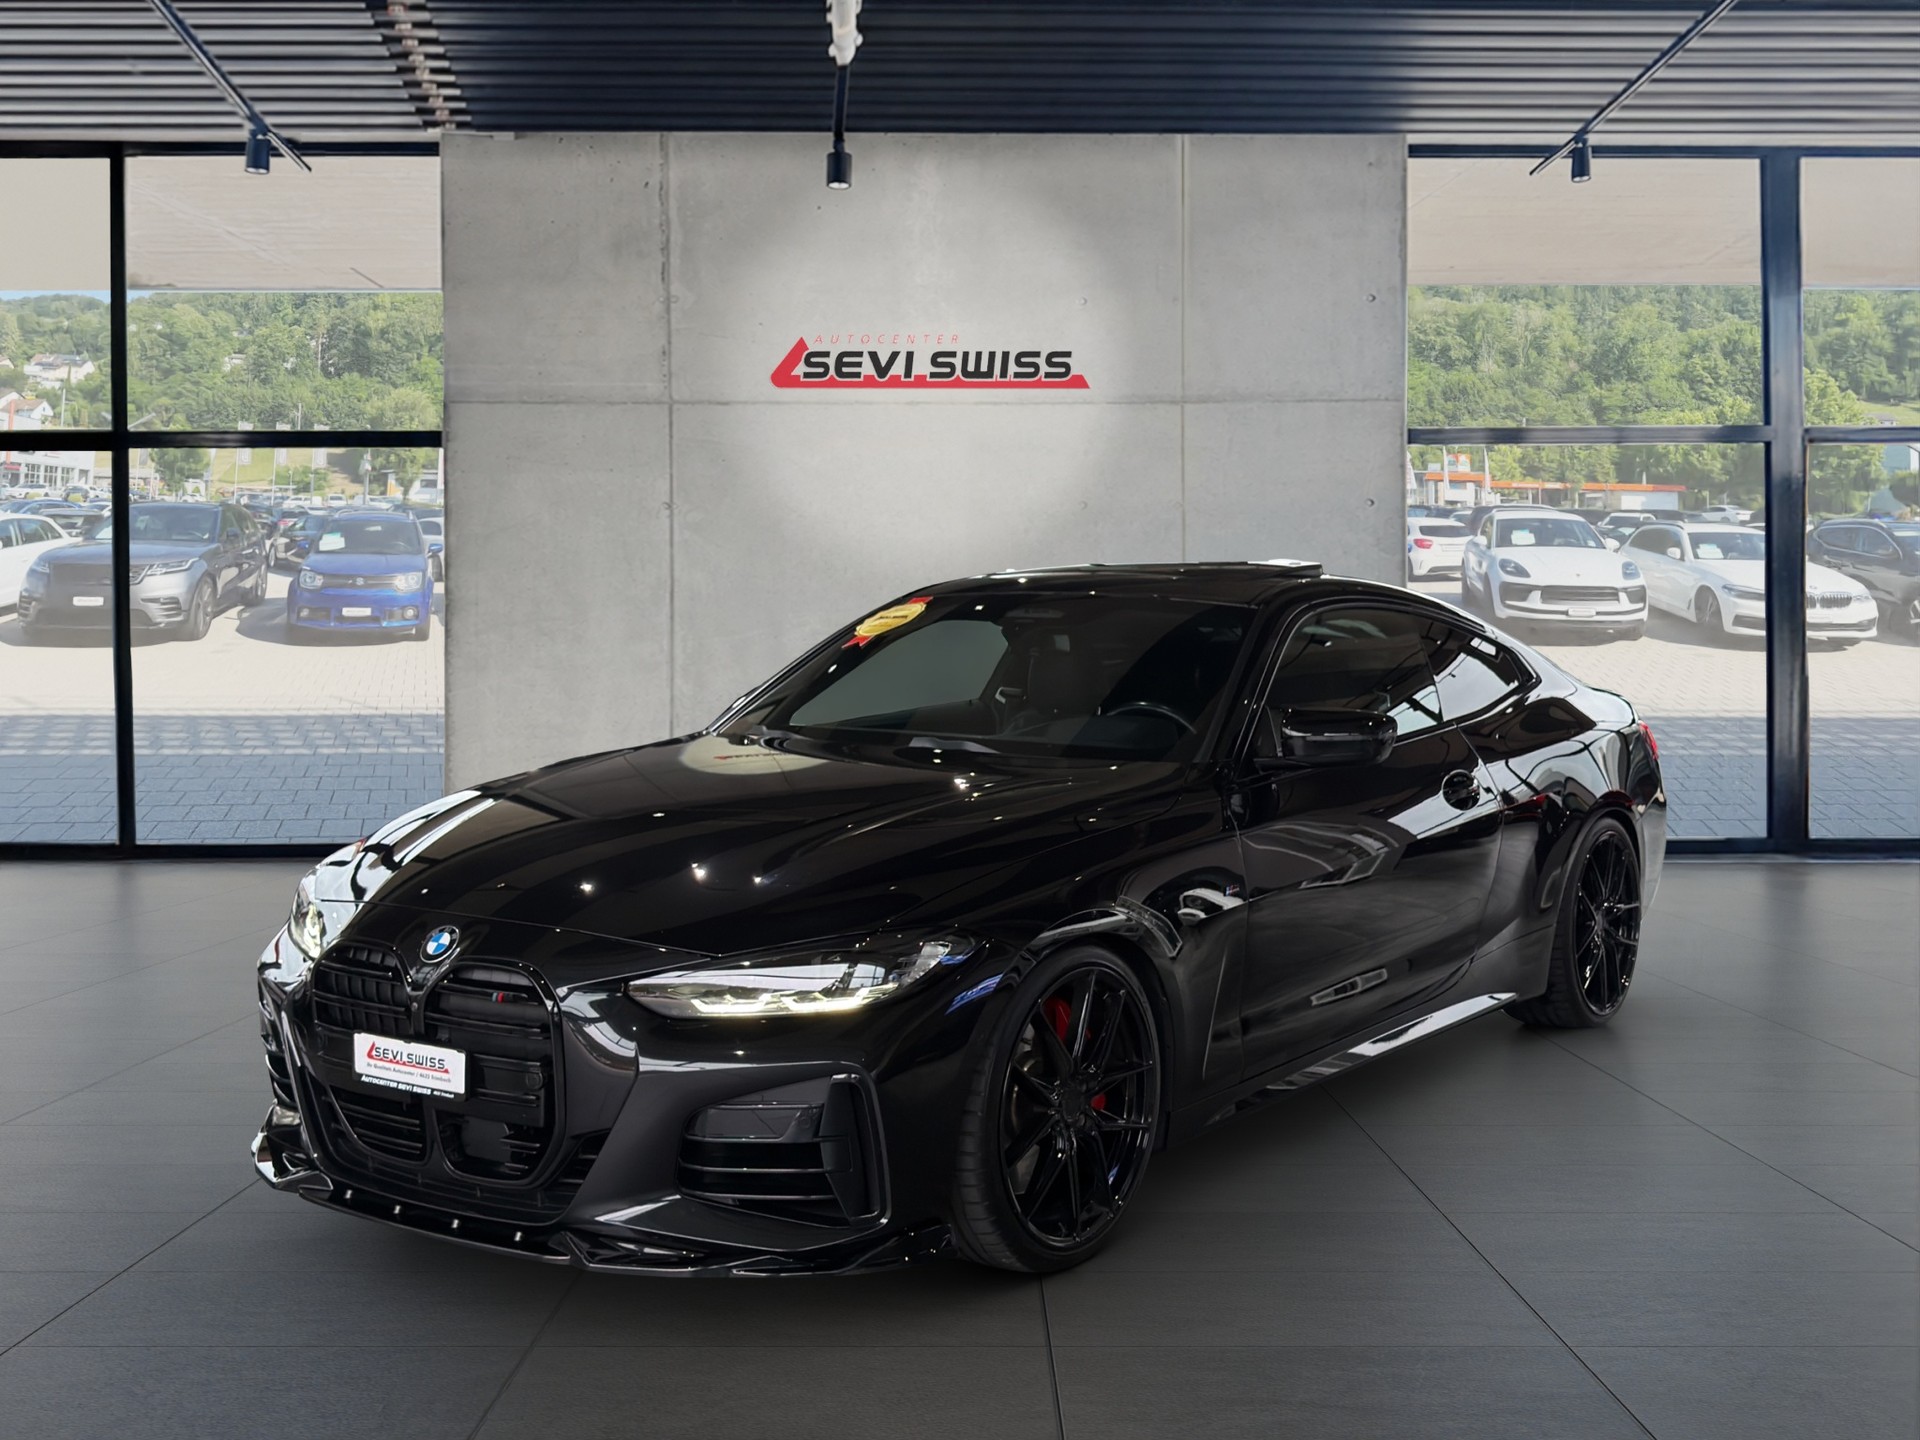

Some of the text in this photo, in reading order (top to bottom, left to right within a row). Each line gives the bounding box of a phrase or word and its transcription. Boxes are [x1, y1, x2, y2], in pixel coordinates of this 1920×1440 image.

[814, 334, 960, 345] AUTOCENTER
[802, 351, 1073, 380] SEVI SWISS
[374, 1047, 446, 1070] SEVI SWISS
